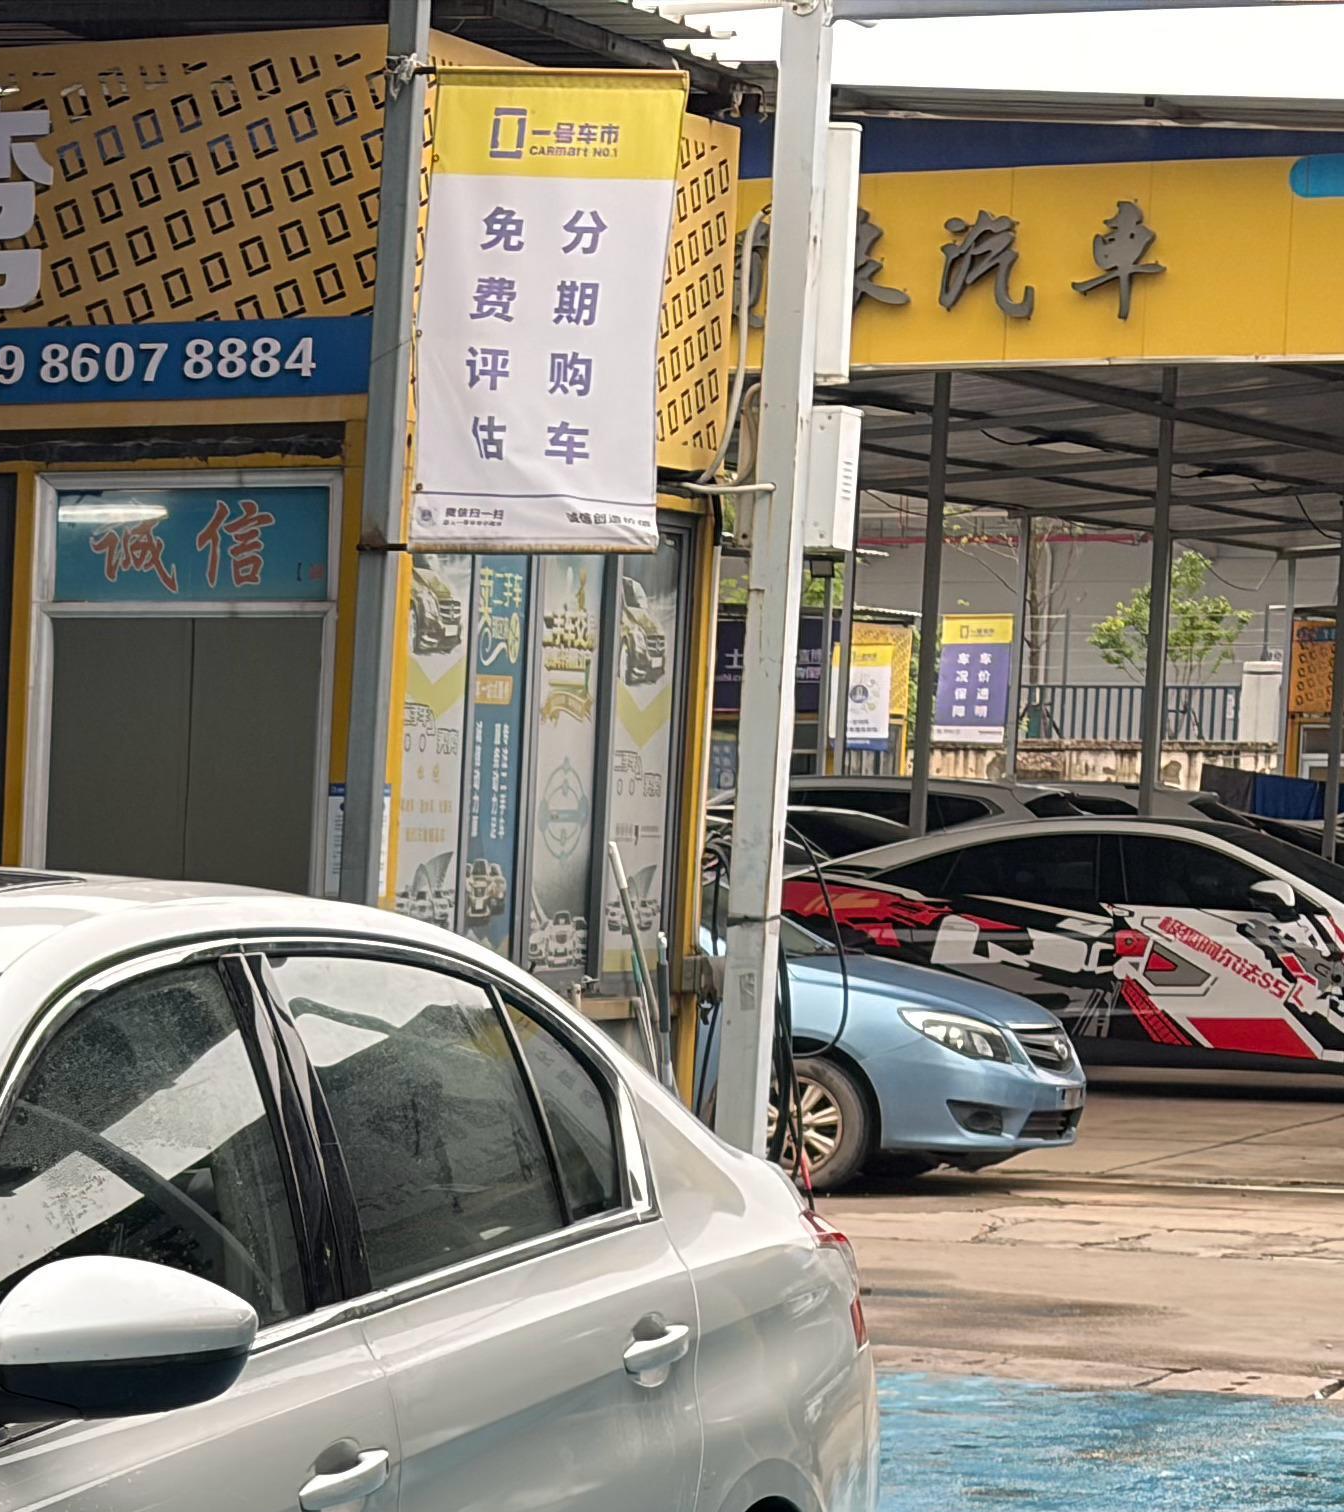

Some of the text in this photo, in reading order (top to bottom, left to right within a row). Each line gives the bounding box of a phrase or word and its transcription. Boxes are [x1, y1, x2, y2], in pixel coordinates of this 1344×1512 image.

[531, 122, 620, 145] 一号车市
[40, 341, 168, 383] 8607
[183, 337, 317, 380] 8884
[465, 206, 526, 463] 免费评估
[546, 209, 608, 466] 分期购车
